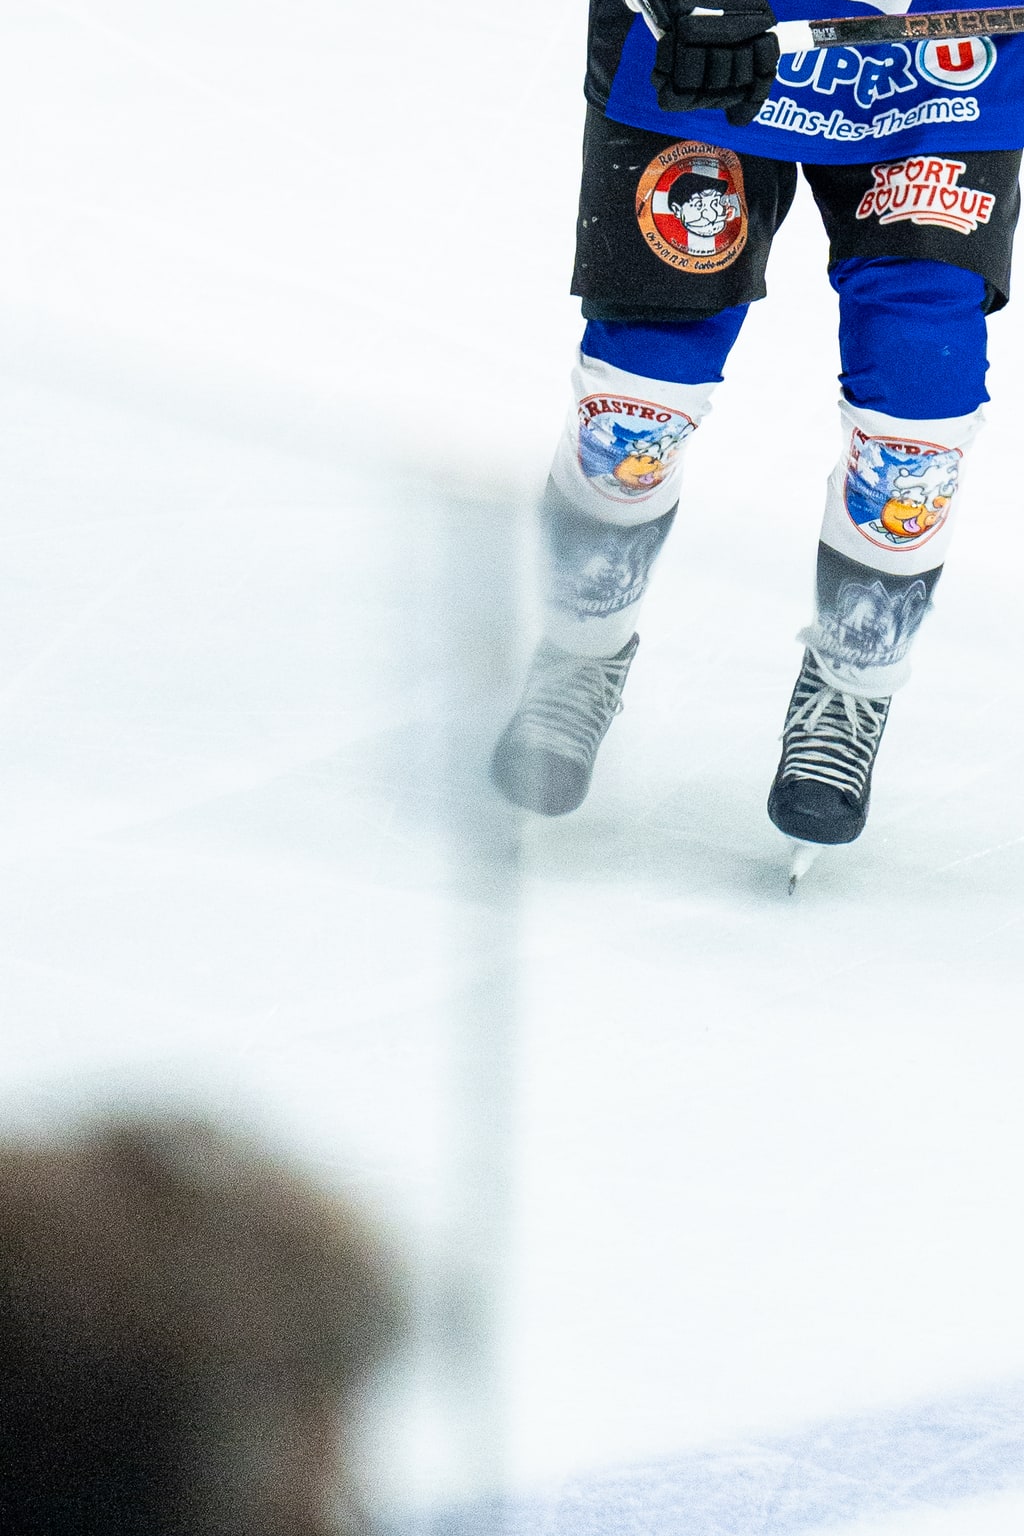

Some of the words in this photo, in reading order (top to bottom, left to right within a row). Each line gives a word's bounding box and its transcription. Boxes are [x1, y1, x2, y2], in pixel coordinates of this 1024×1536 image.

[935, 41, 974, 72] U
[757, 99, 978, 139] alins-les-Thermes
[873, 160, 962, 188] SPORT
[858, 184, 992, 219] BOUTIQUE
